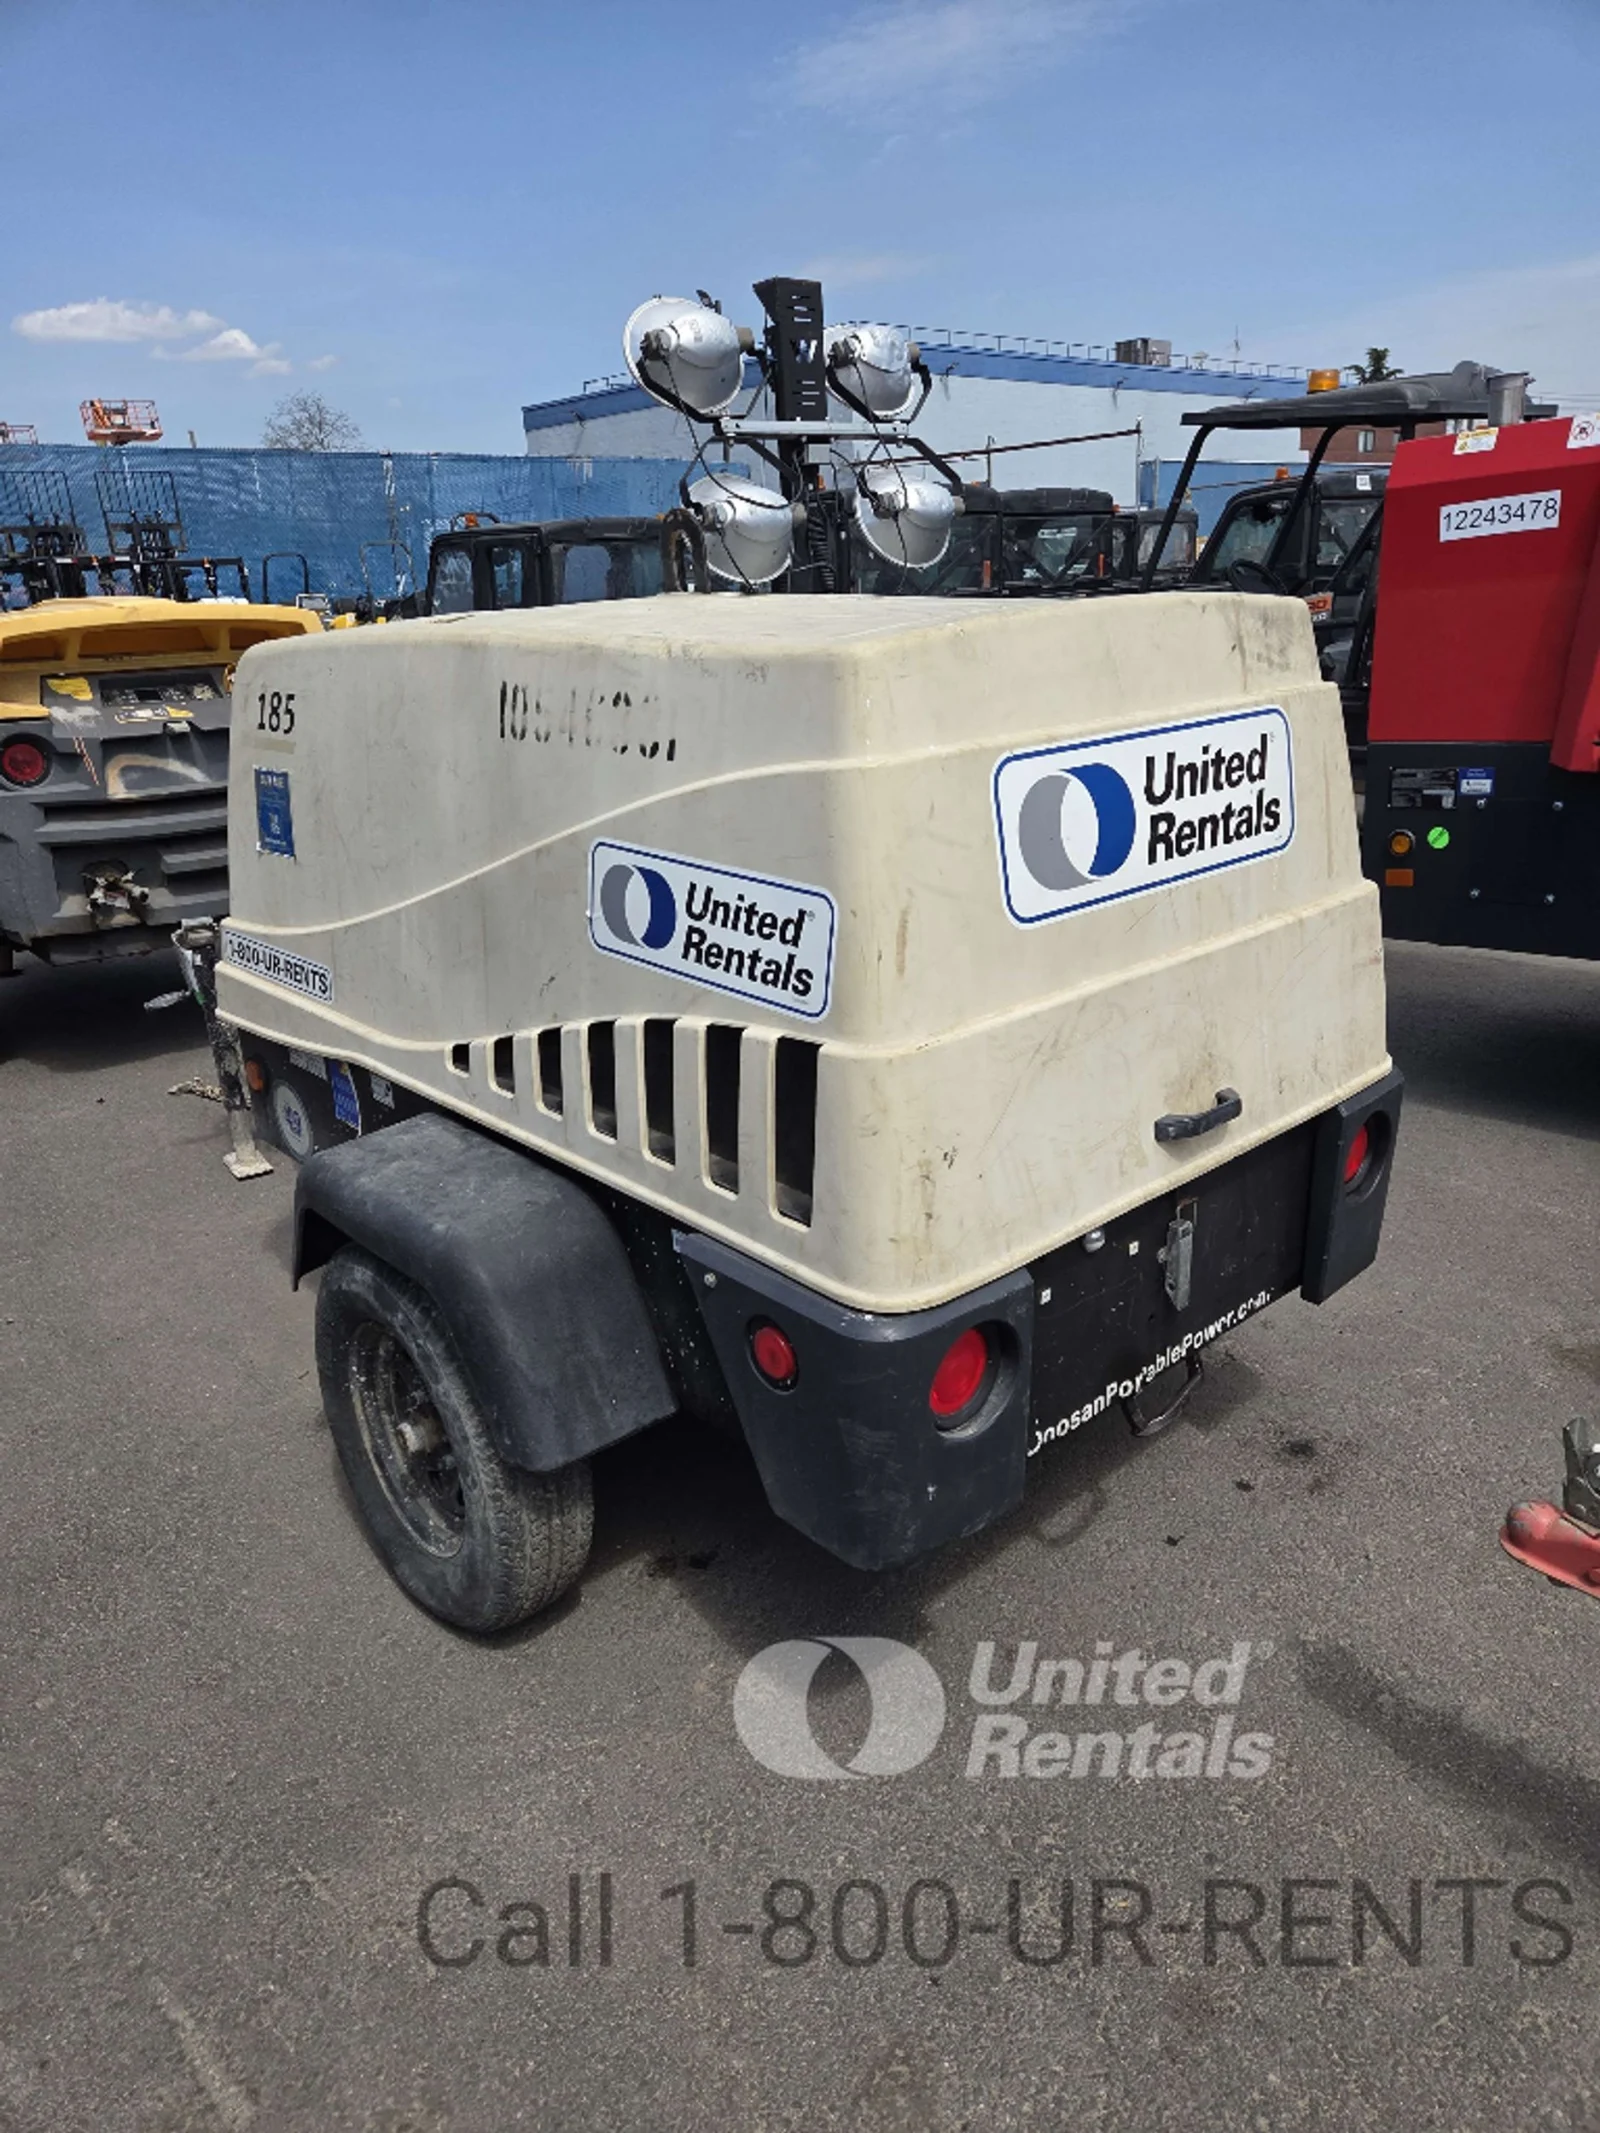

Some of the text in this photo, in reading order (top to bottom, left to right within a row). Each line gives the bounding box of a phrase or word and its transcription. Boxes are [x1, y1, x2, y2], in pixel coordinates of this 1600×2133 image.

[1443, 498, 1558, 532] 12243478
[257, 692, 296, 735] 185
[1143, 732, 1268, 806] United
[1148, 787, 1281, 865] Rentals
[685, 881, 808, 948] United
[681, 925, 815, 997] Rentals
